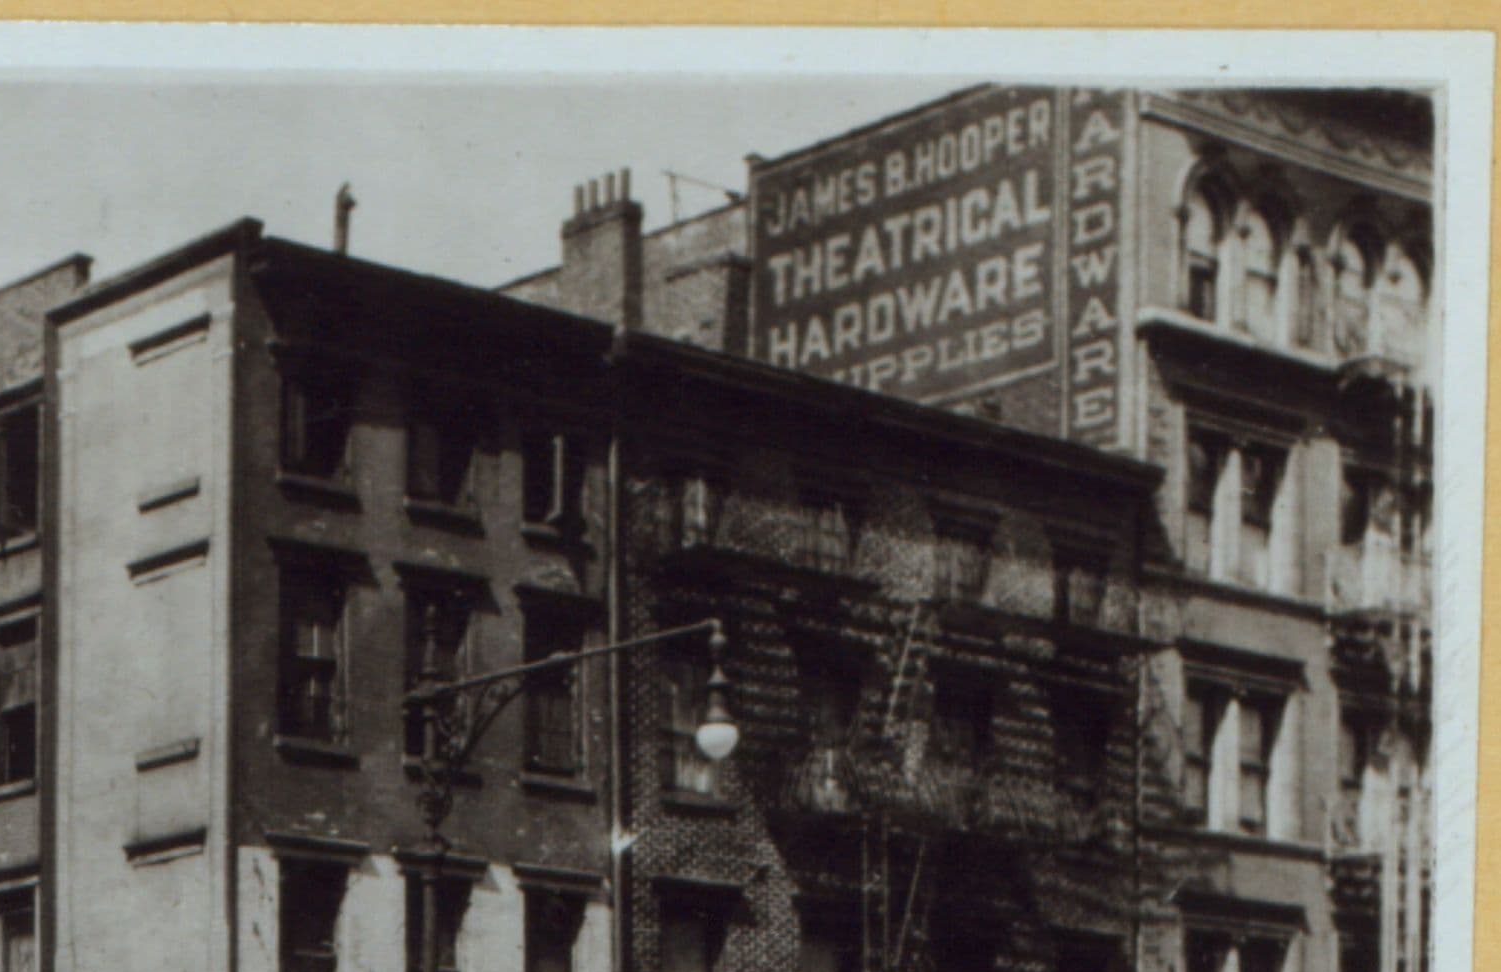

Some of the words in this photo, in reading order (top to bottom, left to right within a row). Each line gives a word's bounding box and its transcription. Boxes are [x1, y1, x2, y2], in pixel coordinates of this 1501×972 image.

[767, 164, 878, 236] JAMES
[915, 98, 1051, 184] HOOPER
[767, 170, 1052, 305] THEATRICAL
[768, 242, 1045, 369] HARDWARE
[1070, 90, 1120, 429] ARDWARE
